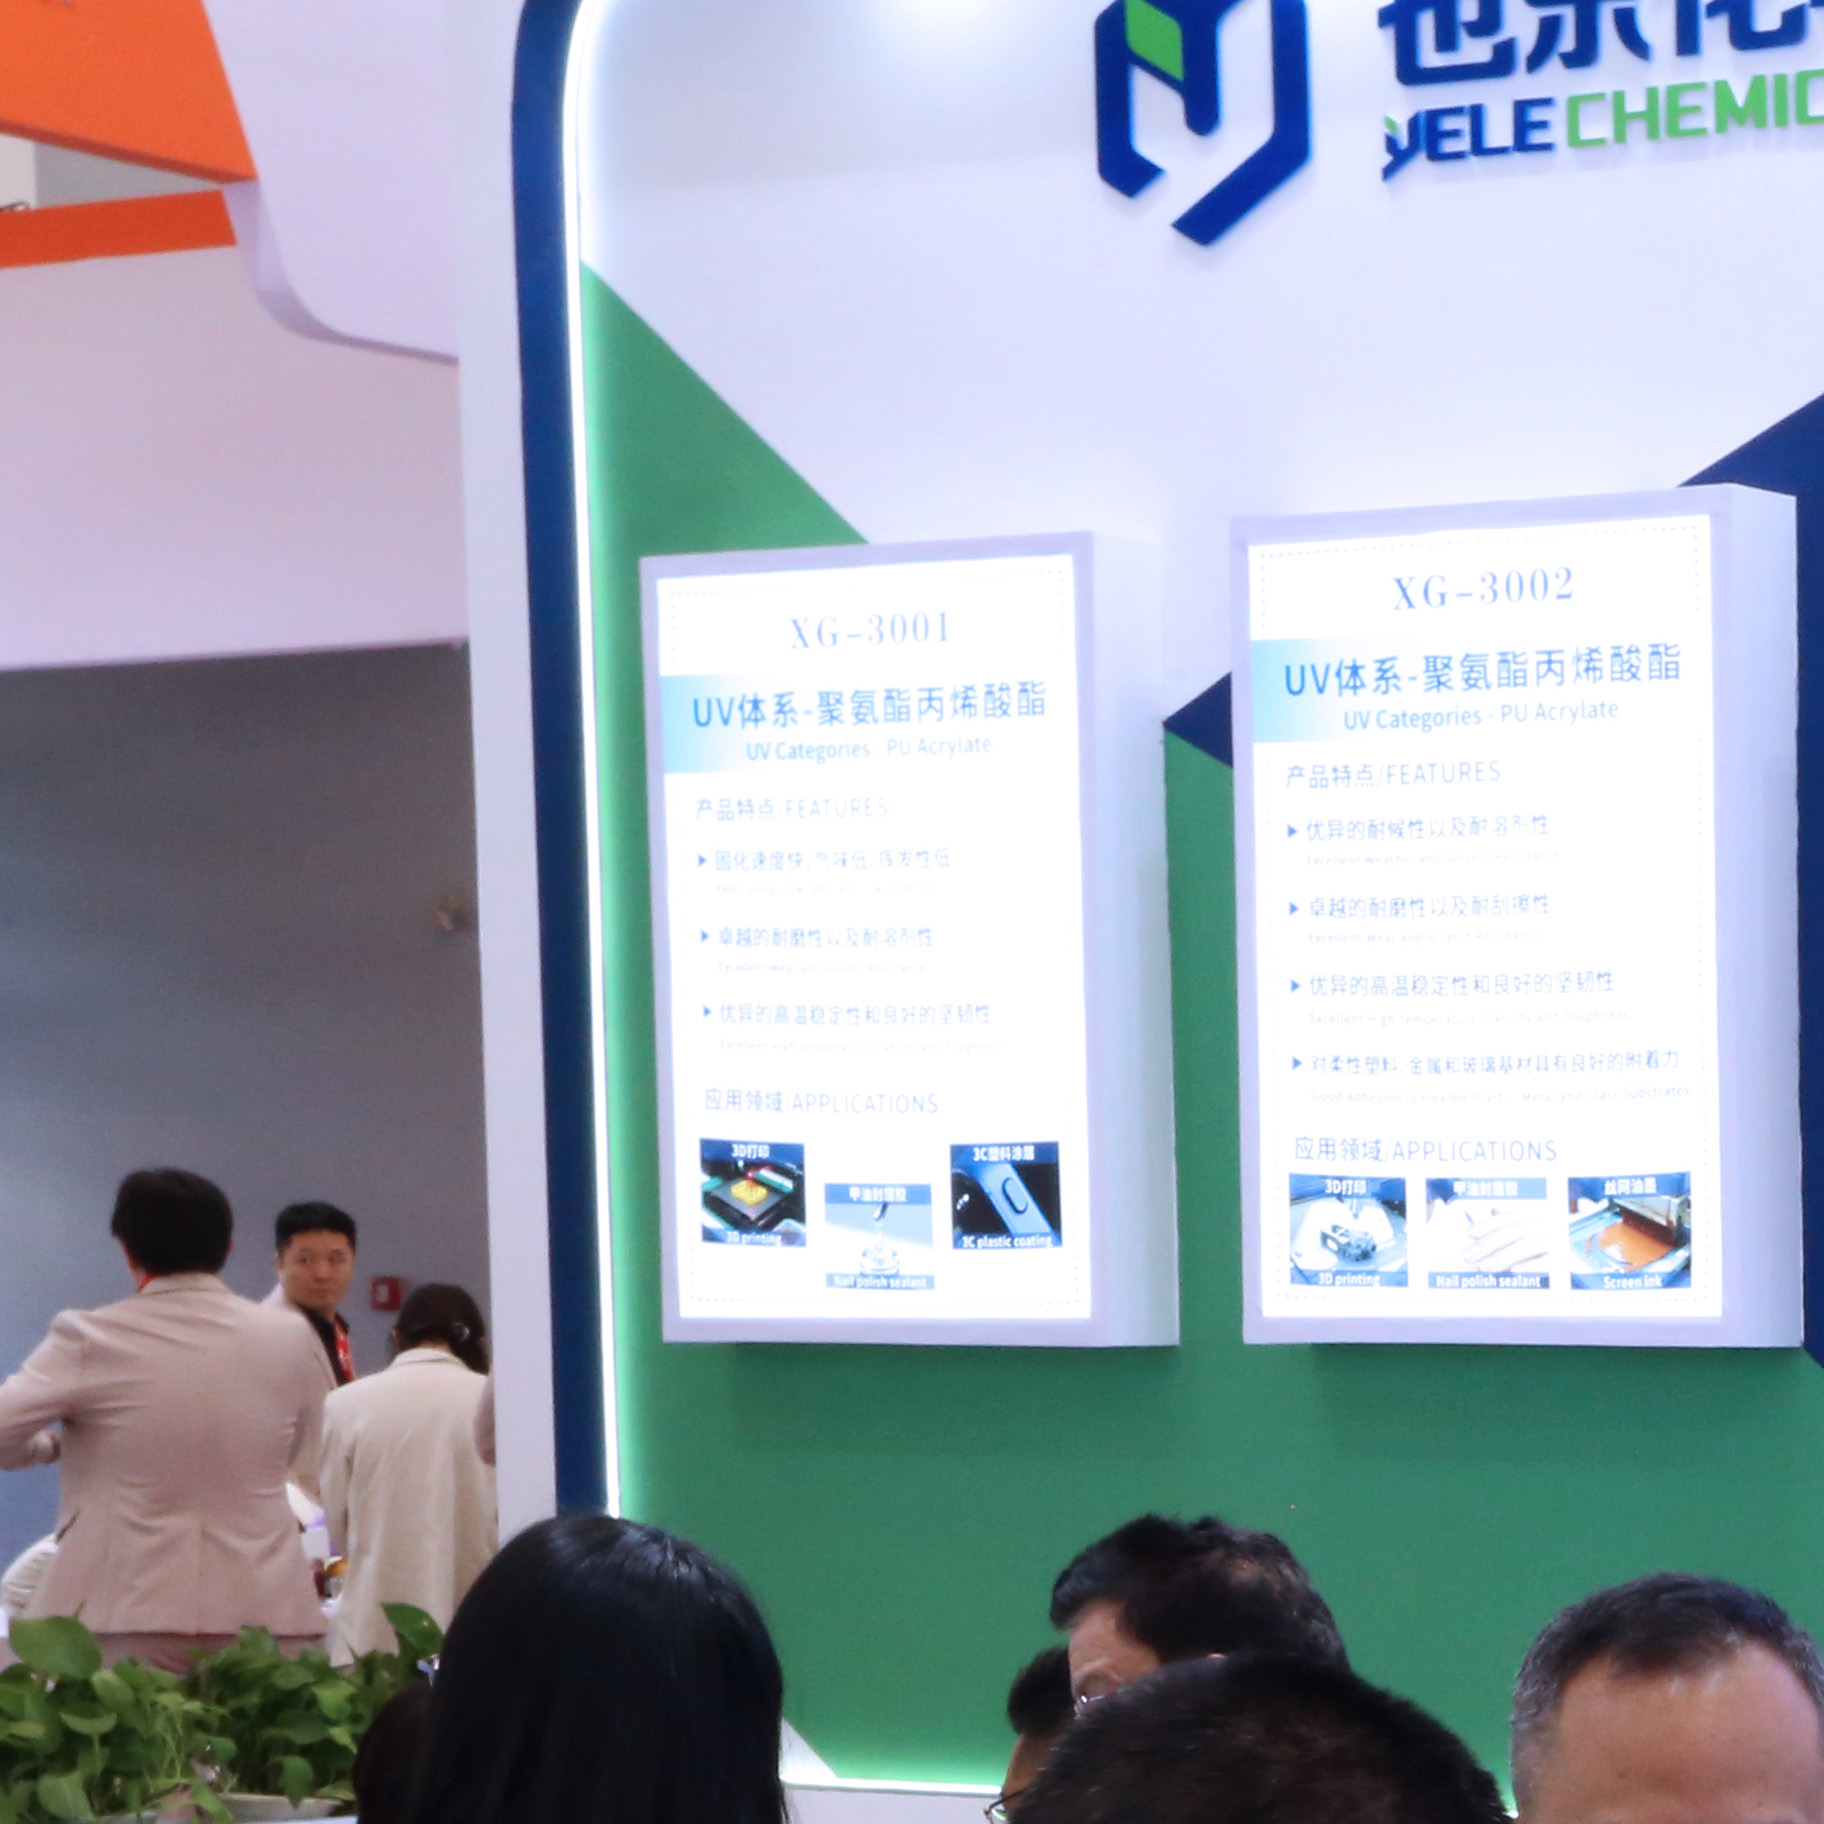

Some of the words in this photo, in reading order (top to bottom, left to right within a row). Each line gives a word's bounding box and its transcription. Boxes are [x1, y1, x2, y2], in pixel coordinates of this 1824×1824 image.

[1392, 566, 1574, 611] XG-3002
[789, 611, 950, 650] XG-3001
[1284, 642, 1682, 698] UV体系-聚氨酯丙烯酸酯
[693, 680, 1047, 729] UV体系-聚氨酯丙烯酸酯
[1344, 710, 1371, 730] UV
[1375, 705, 1482, 733] Categories
[1501, 704, 1528, 723] PU
[1535, 700, 1619, 725] Acrylate
[746, 742, 771, 761] UV
[775, 738, 871, 764] Categories
[887, 737, 912, 756] PU
[917, 735, 992, 759] Acrylate
[1286, 760, 1501, 789] 产品特点/FEATURES
[696, 797, 888, 822] 产品特点/FEATURES
[1309, 970, 1616, 997] 优异的高温稳定性和良好的坚韧性
[705, 1087, 939, 1114] 应用领域/APPLICATIONS
[731, 1143, 771, 1159] 3D打印
[1294, 1136, 1558, 1163] 应用领域/APPLICATIONS
[1325, 1179, 1367, 1195] 3D打印
[741, 1231, 783, 1247] printing
[977, 1235, 1012, 1250] plastic
[1013, 1235, 1053, 1250] coating
[856, 1276, 888, 1290] polish
[889, 1277, 928, 1289] sealant
[1318, 1273, 1333, 1286] 3D
[1335, 1273, 1381, 1288] printing
[1436, 1275, 1459, 1288] Nail
[1461, 1275, 1497, 1290] polish
[1499, 1276, 1541, 1288] sealant
[1603, 1276, 1643, 1289] Screen
[1645, 1275, 1663, 1288] ink
